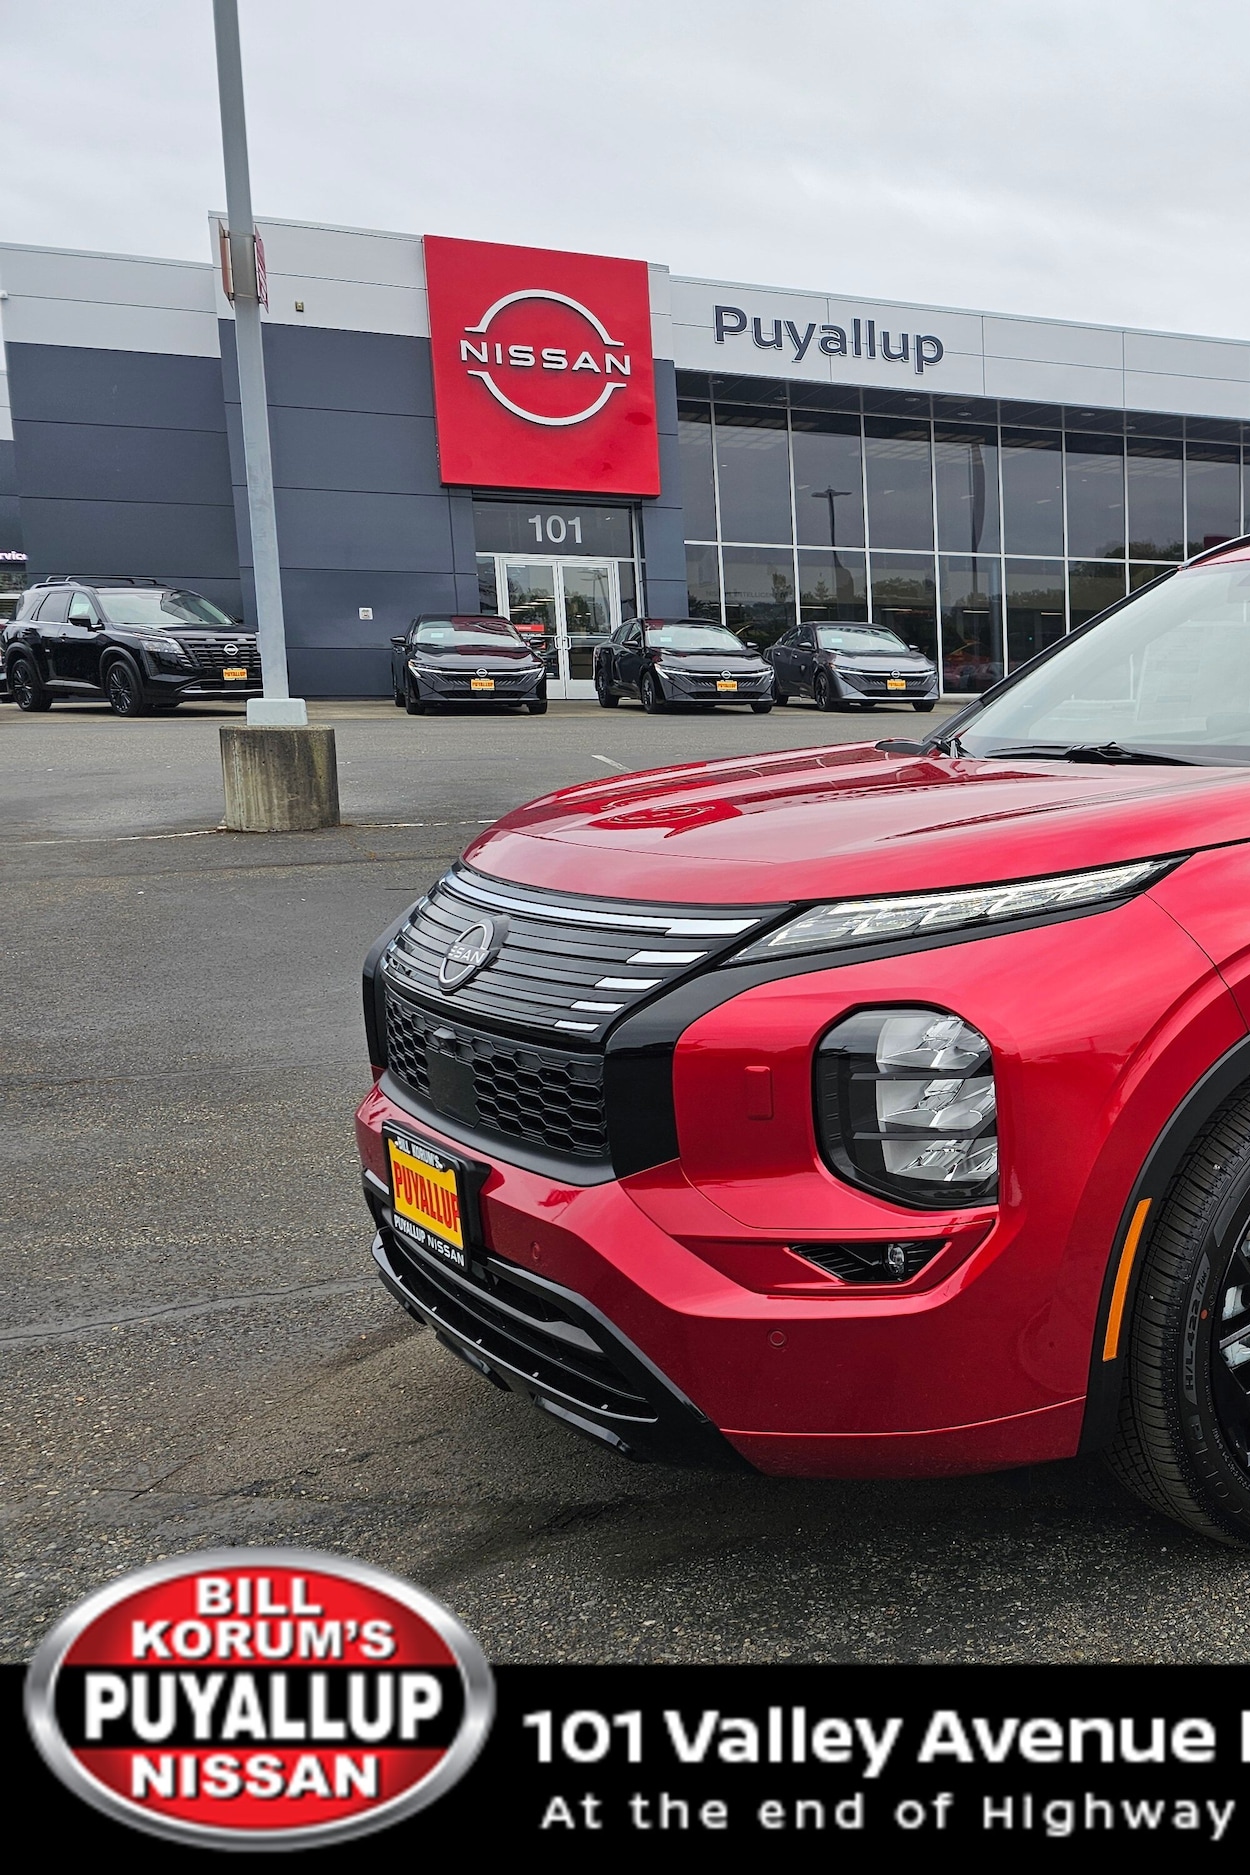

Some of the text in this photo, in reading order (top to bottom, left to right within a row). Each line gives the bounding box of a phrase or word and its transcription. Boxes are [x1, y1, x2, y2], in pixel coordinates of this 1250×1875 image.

[460, 339, 631, 375] NISSAN
[713, 304, 944, 374] Puyallup
[528, 514, 582, 543] 101
[397, 1136, 411, 1155] BILL
[393, 1160, 461, 1233] PUYALLUP
[393, 1213, 465, 1268] PUYALLUP NISSAN
